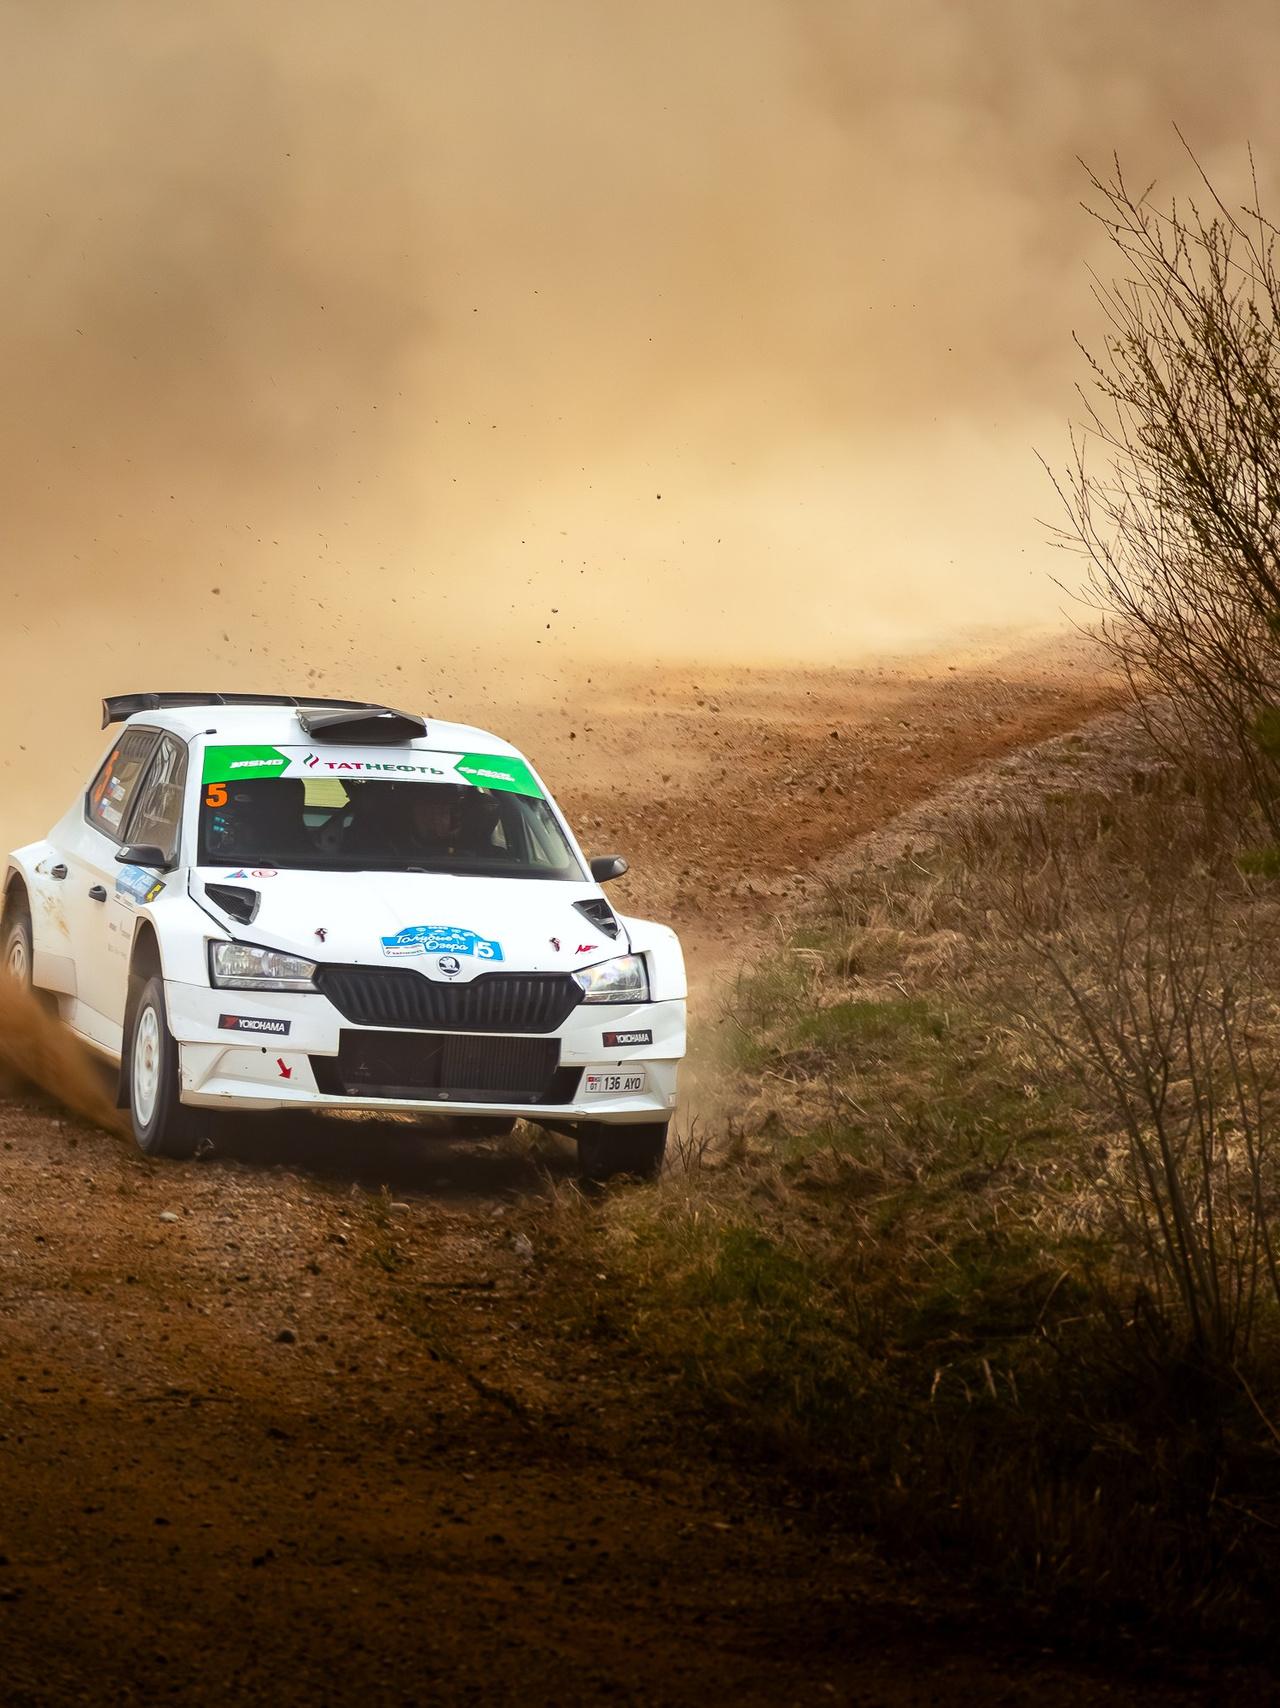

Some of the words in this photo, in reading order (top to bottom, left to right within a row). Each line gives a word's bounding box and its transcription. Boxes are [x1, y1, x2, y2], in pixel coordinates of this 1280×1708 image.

[324, 762, 444, 775] ТАТНЕФТЬ
[206, 784, 227, 807] 5
[478, 942, 494, 958] 5
[239, 1019, 285, 1032] YOKOHAMA
[616, 1033, 650, 1043] YOKOHAMA
[604, 1077, 621, 1090] 136
